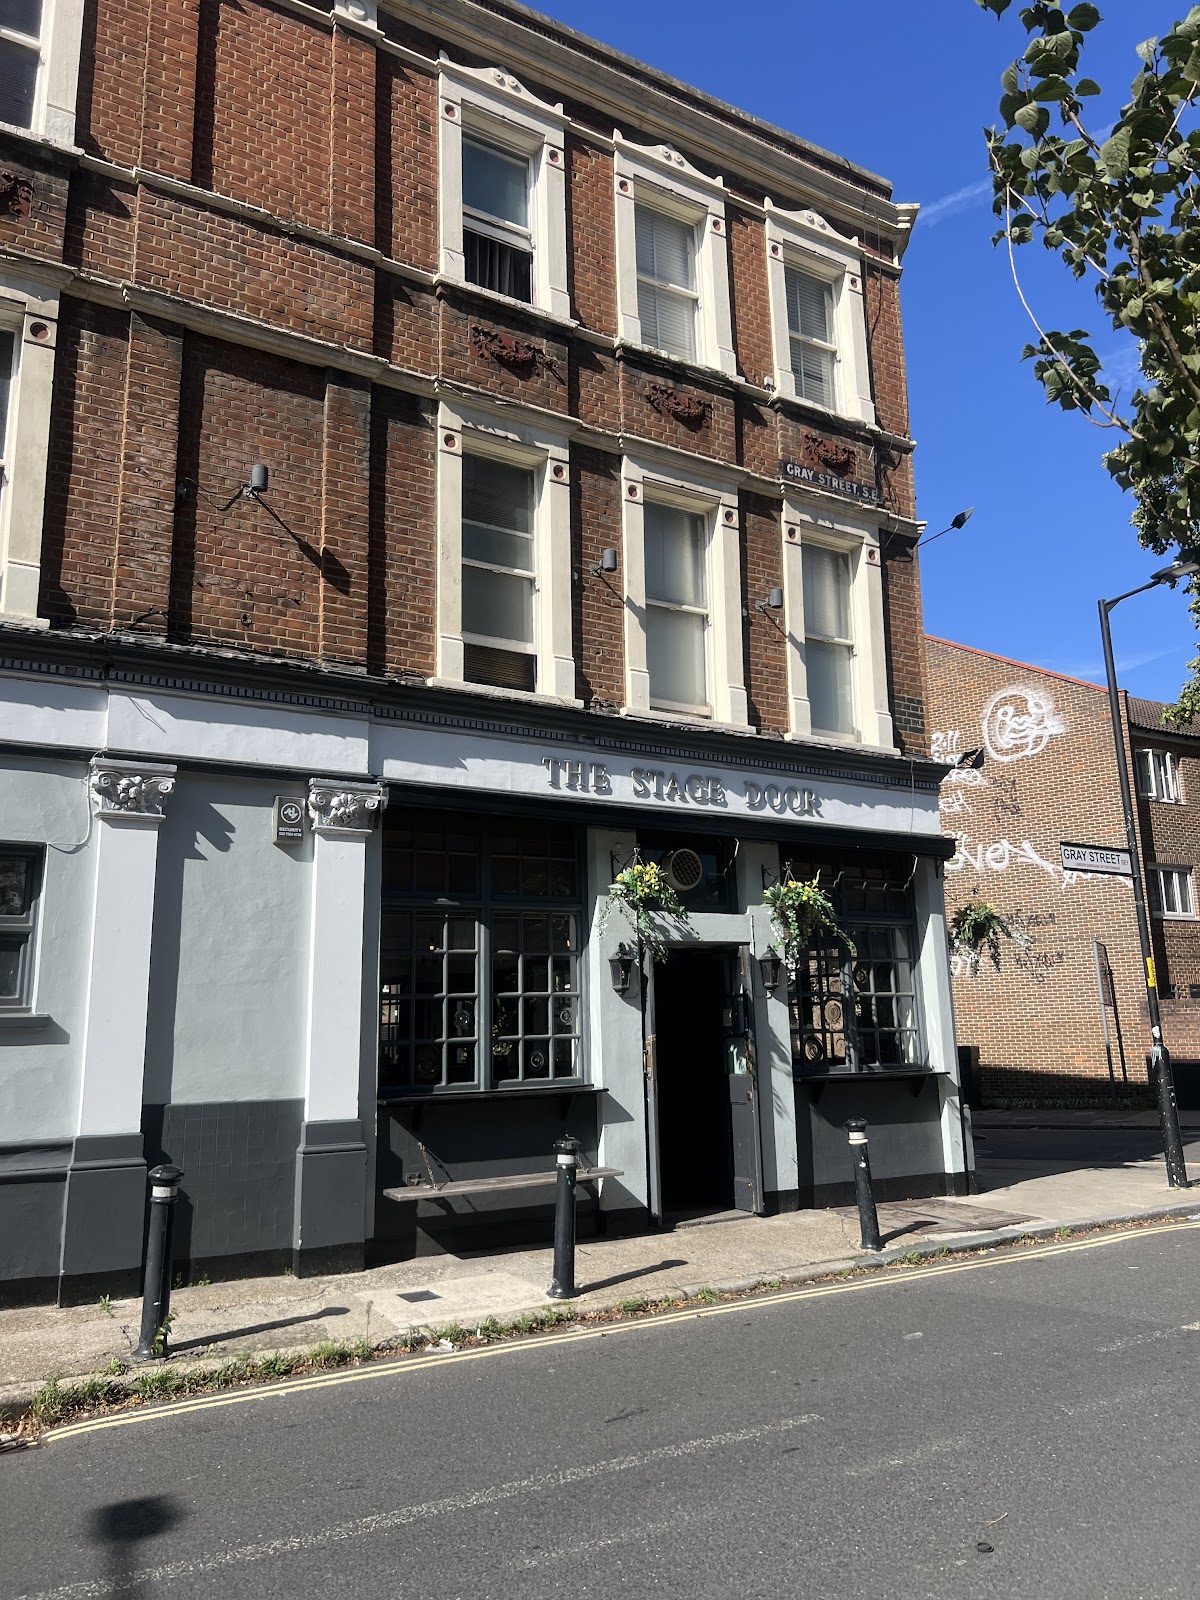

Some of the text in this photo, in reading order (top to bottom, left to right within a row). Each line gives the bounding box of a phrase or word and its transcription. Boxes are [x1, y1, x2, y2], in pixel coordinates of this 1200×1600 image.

[787, 463, 814, 481] GRAY
[542, 757, 821, 814] THE STAGE DOOR
[1063, 848, 1086, 861] GRAY
[1089, 851, 1120, 864] STREET
